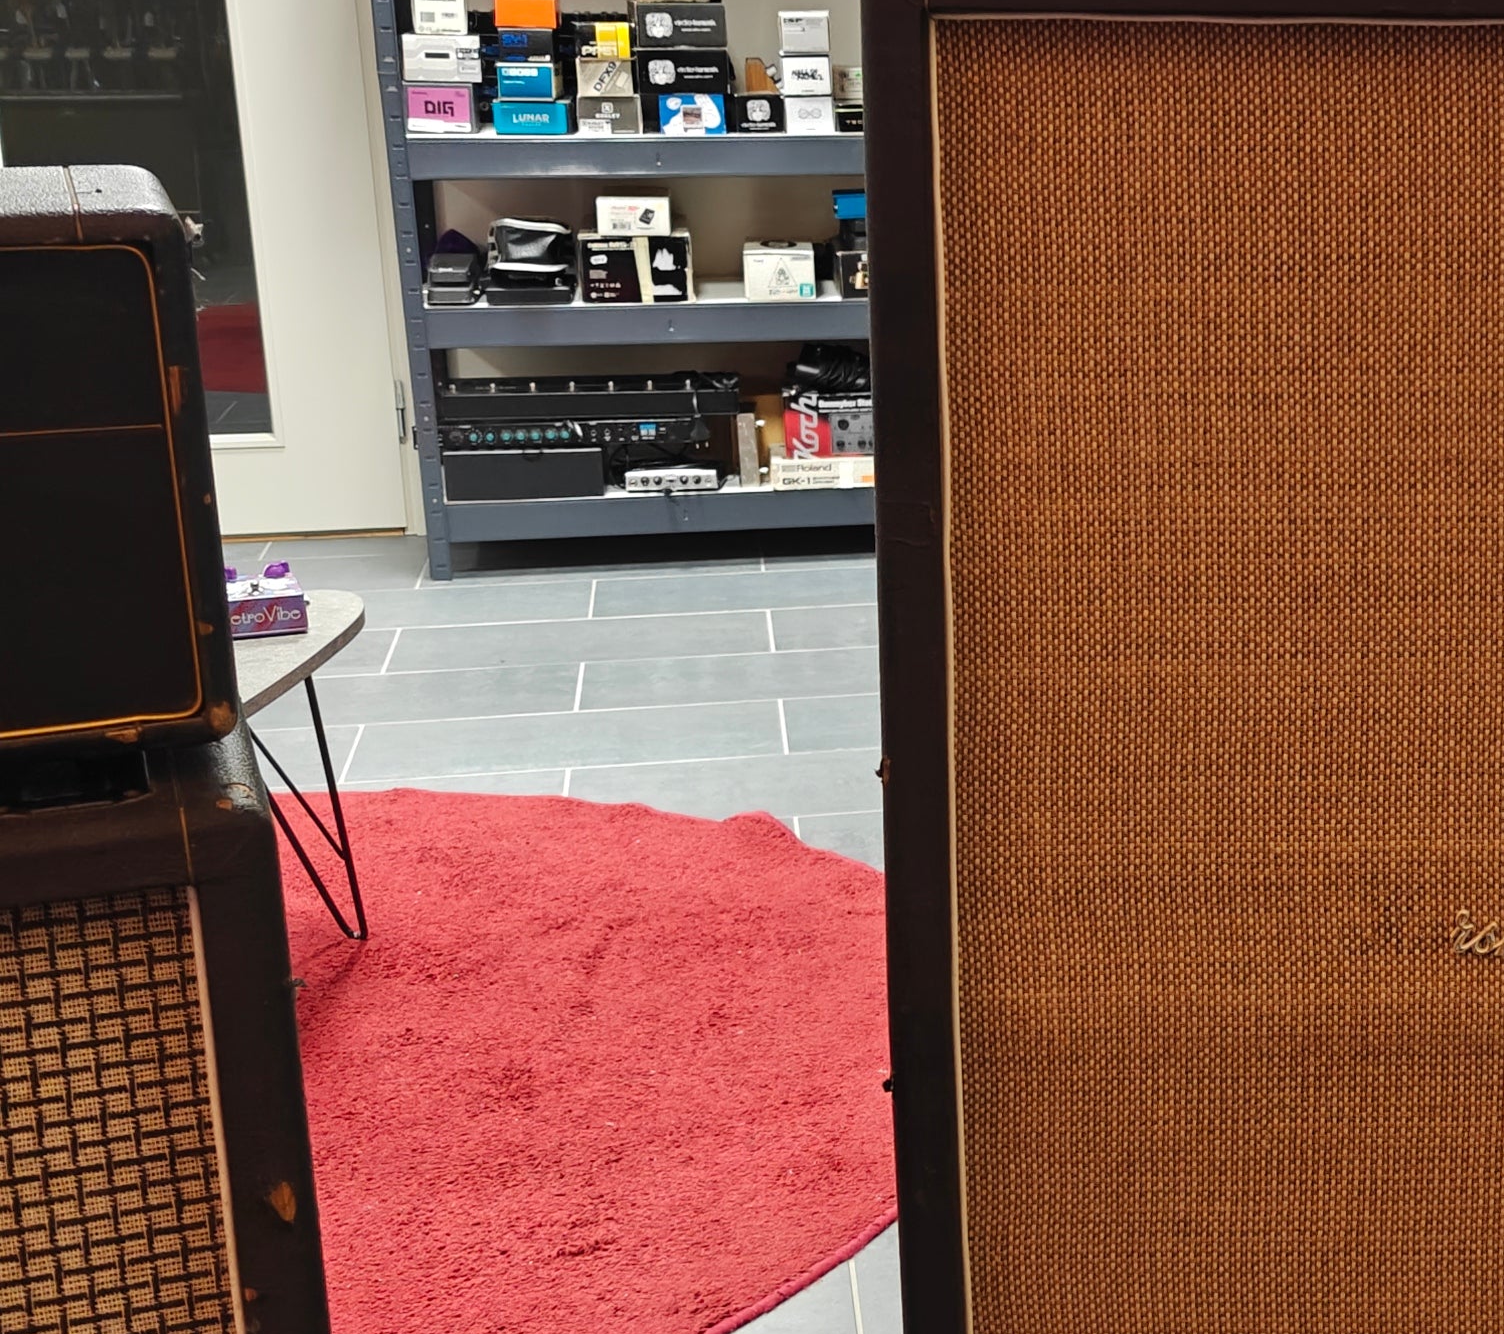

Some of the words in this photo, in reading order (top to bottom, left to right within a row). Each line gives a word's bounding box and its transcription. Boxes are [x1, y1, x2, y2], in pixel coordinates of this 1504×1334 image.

[424, 100, 454, 116] DIG
[512, 113, 549, 123] LUNAR
[798, 463, 832, 472] Roland
[230, 605, 301, 626] etroVibe
